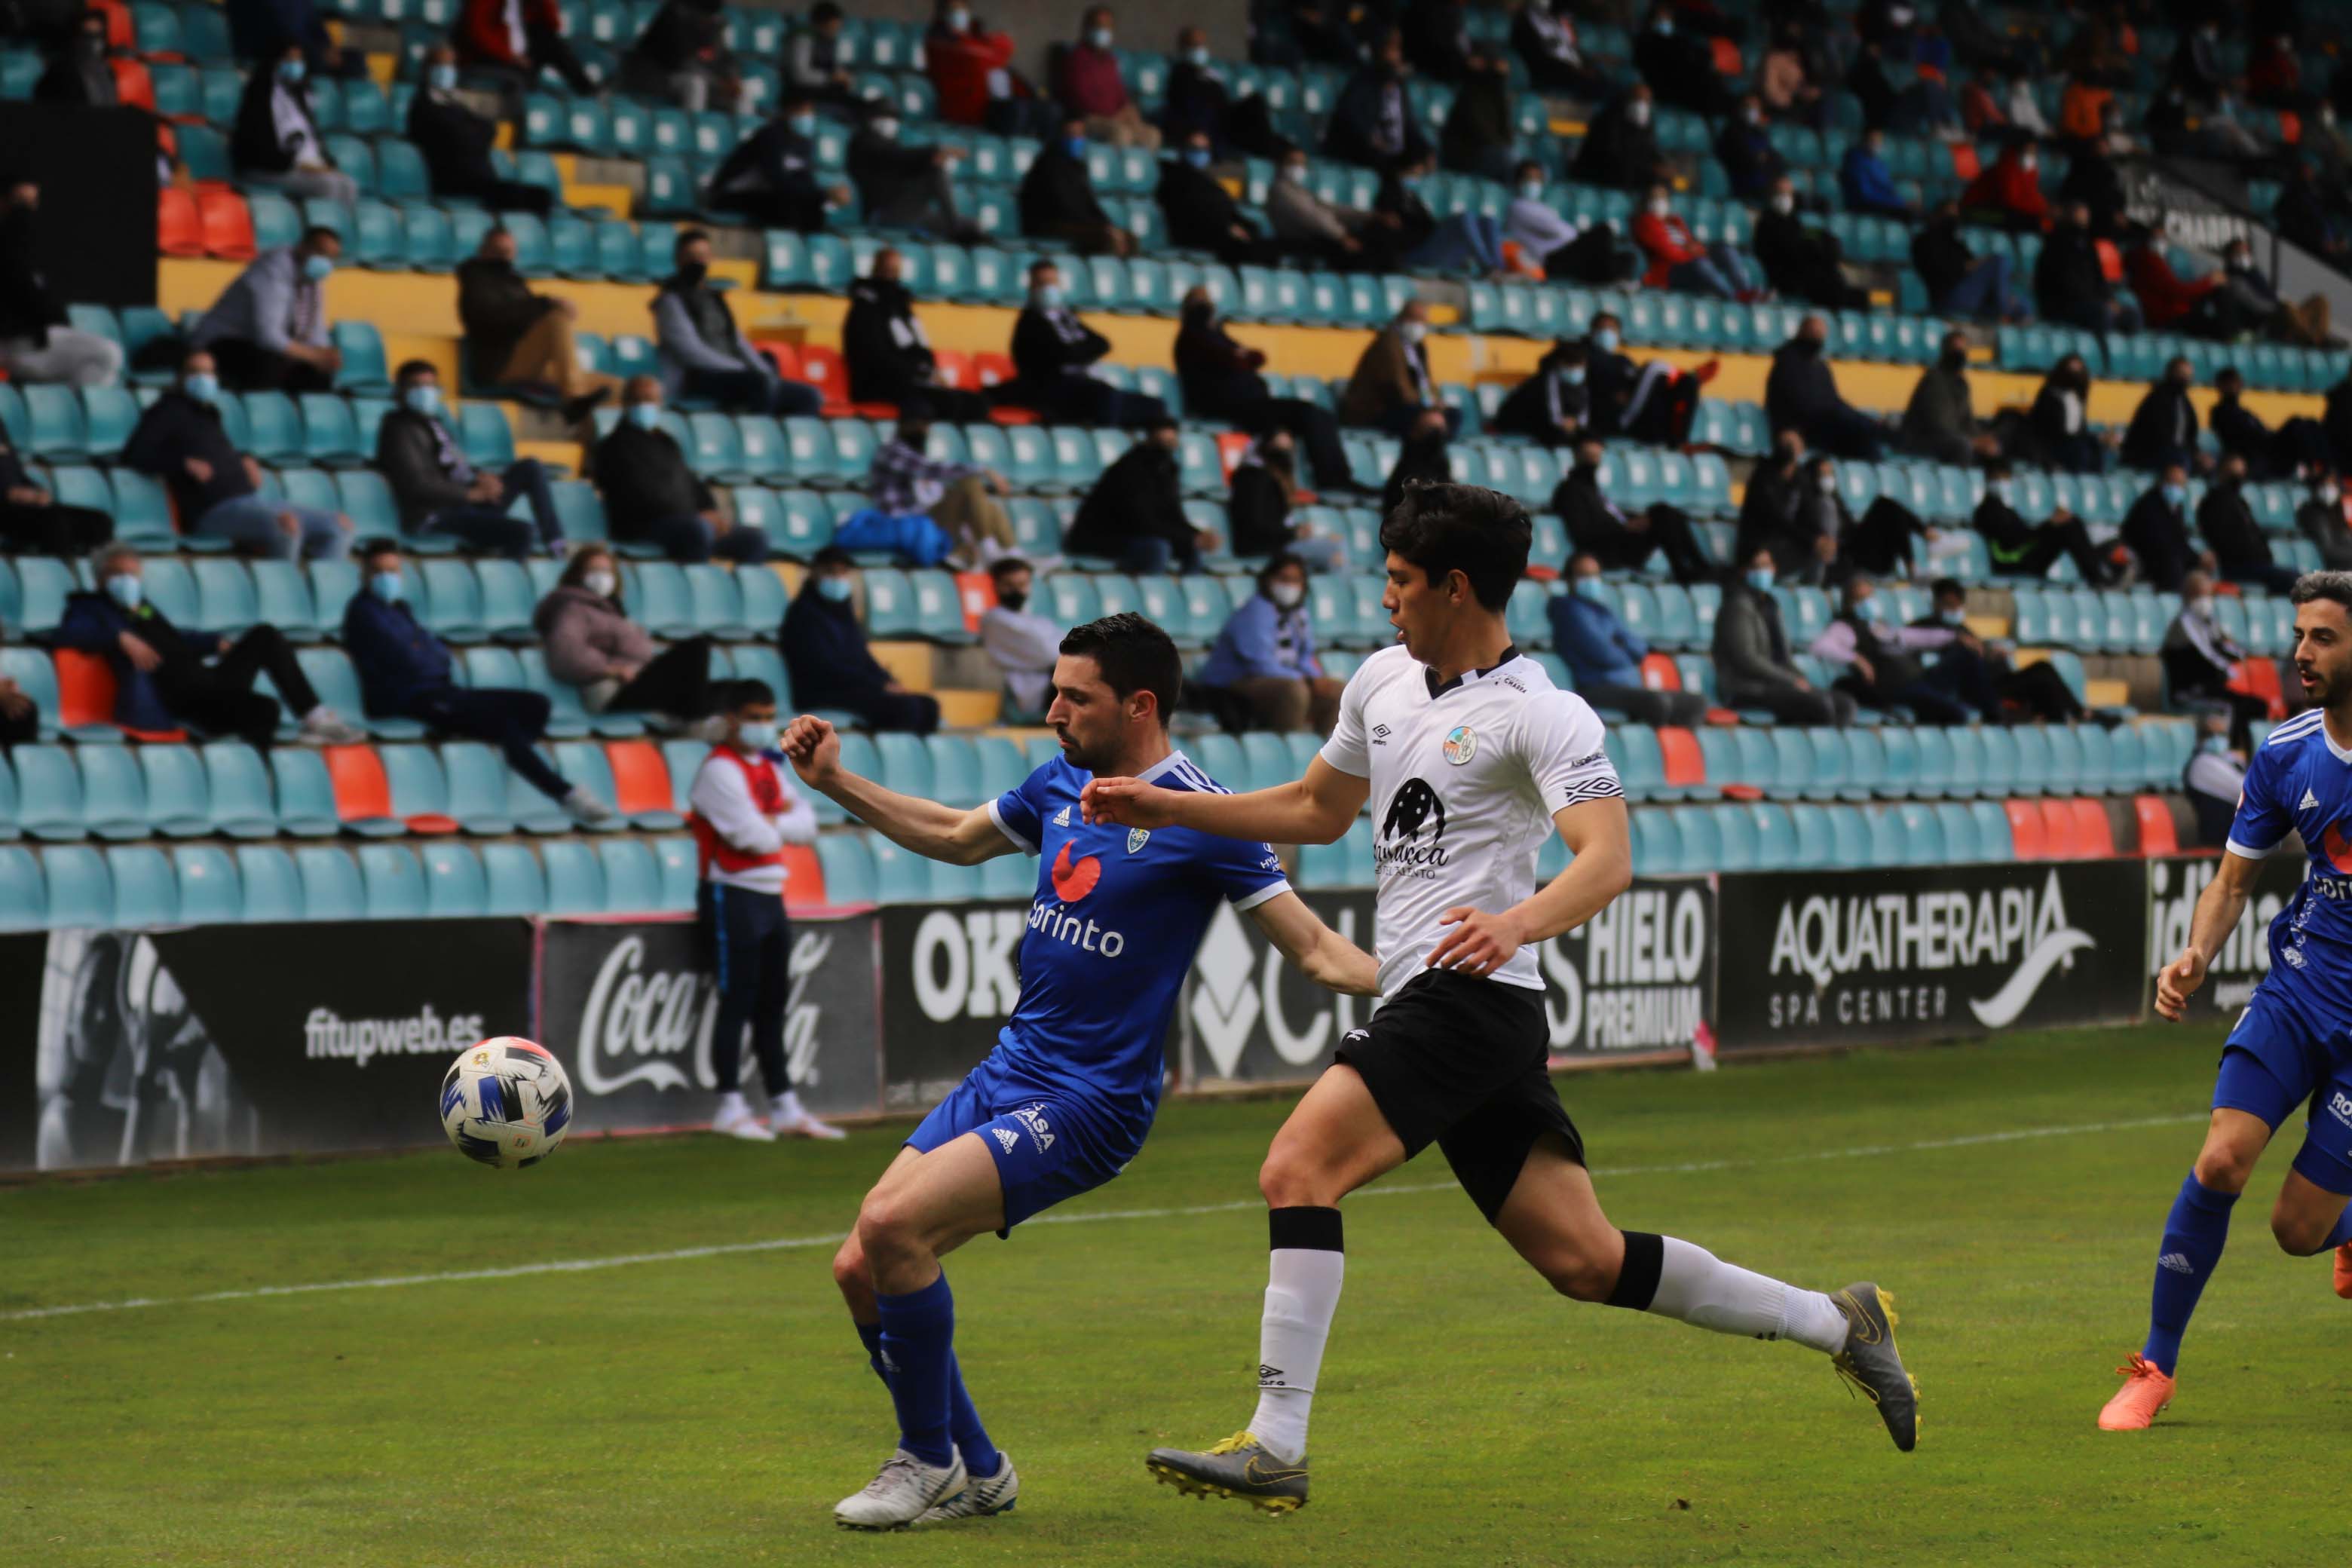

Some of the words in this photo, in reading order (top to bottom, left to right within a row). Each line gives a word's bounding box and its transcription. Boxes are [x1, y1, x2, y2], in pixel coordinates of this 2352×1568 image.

[1586, 887, 1705, 986] HIELO
[1770, 868, 2077, 986] AQUATHERAPIA
[304, 1005, 484, 1066] fitupweb.es
[1585, 986, 1704, 1049] PREMIUM
[1769, 993, 1821, 1028] SPA
[1837, 986, 1947, 1024] CENTER
